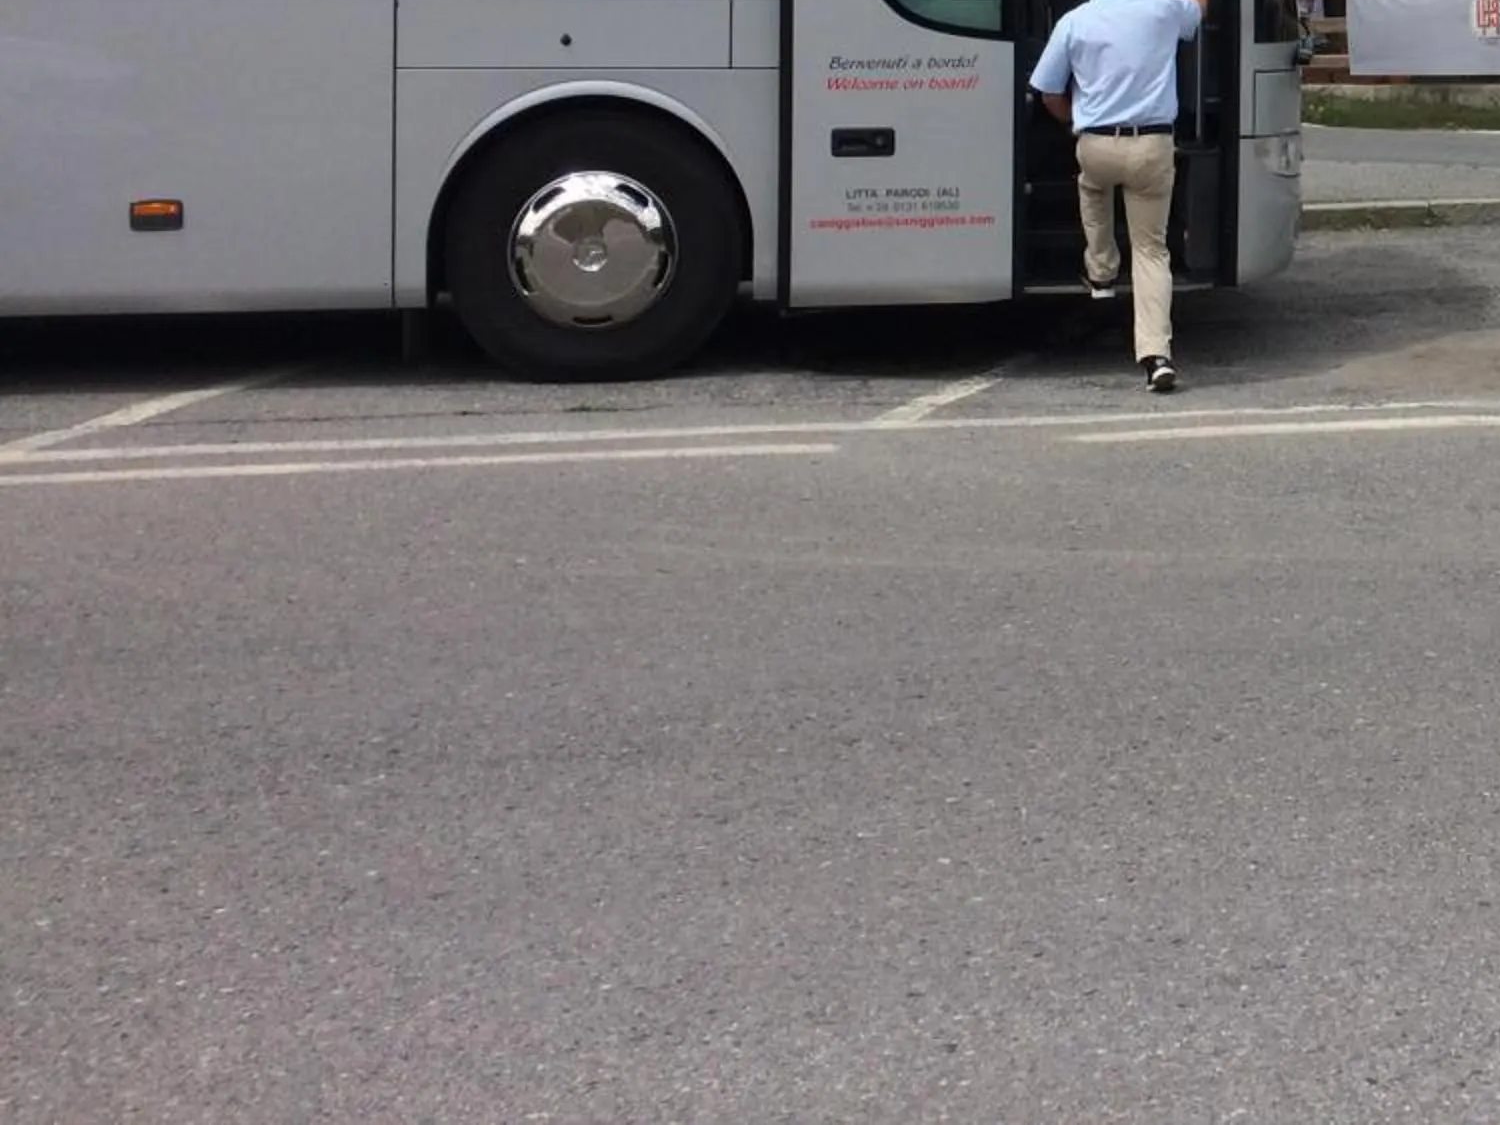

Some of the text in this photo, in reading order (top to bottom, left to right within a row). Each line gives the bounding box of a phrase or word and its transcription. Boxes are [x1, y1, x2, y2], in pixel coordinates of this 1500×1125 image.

[829, 54, 978, 71] Benvenuti a bordo!
[826, 74, 979, 91] Welcome on board!
[845, 188, 878, 200] LITTA
